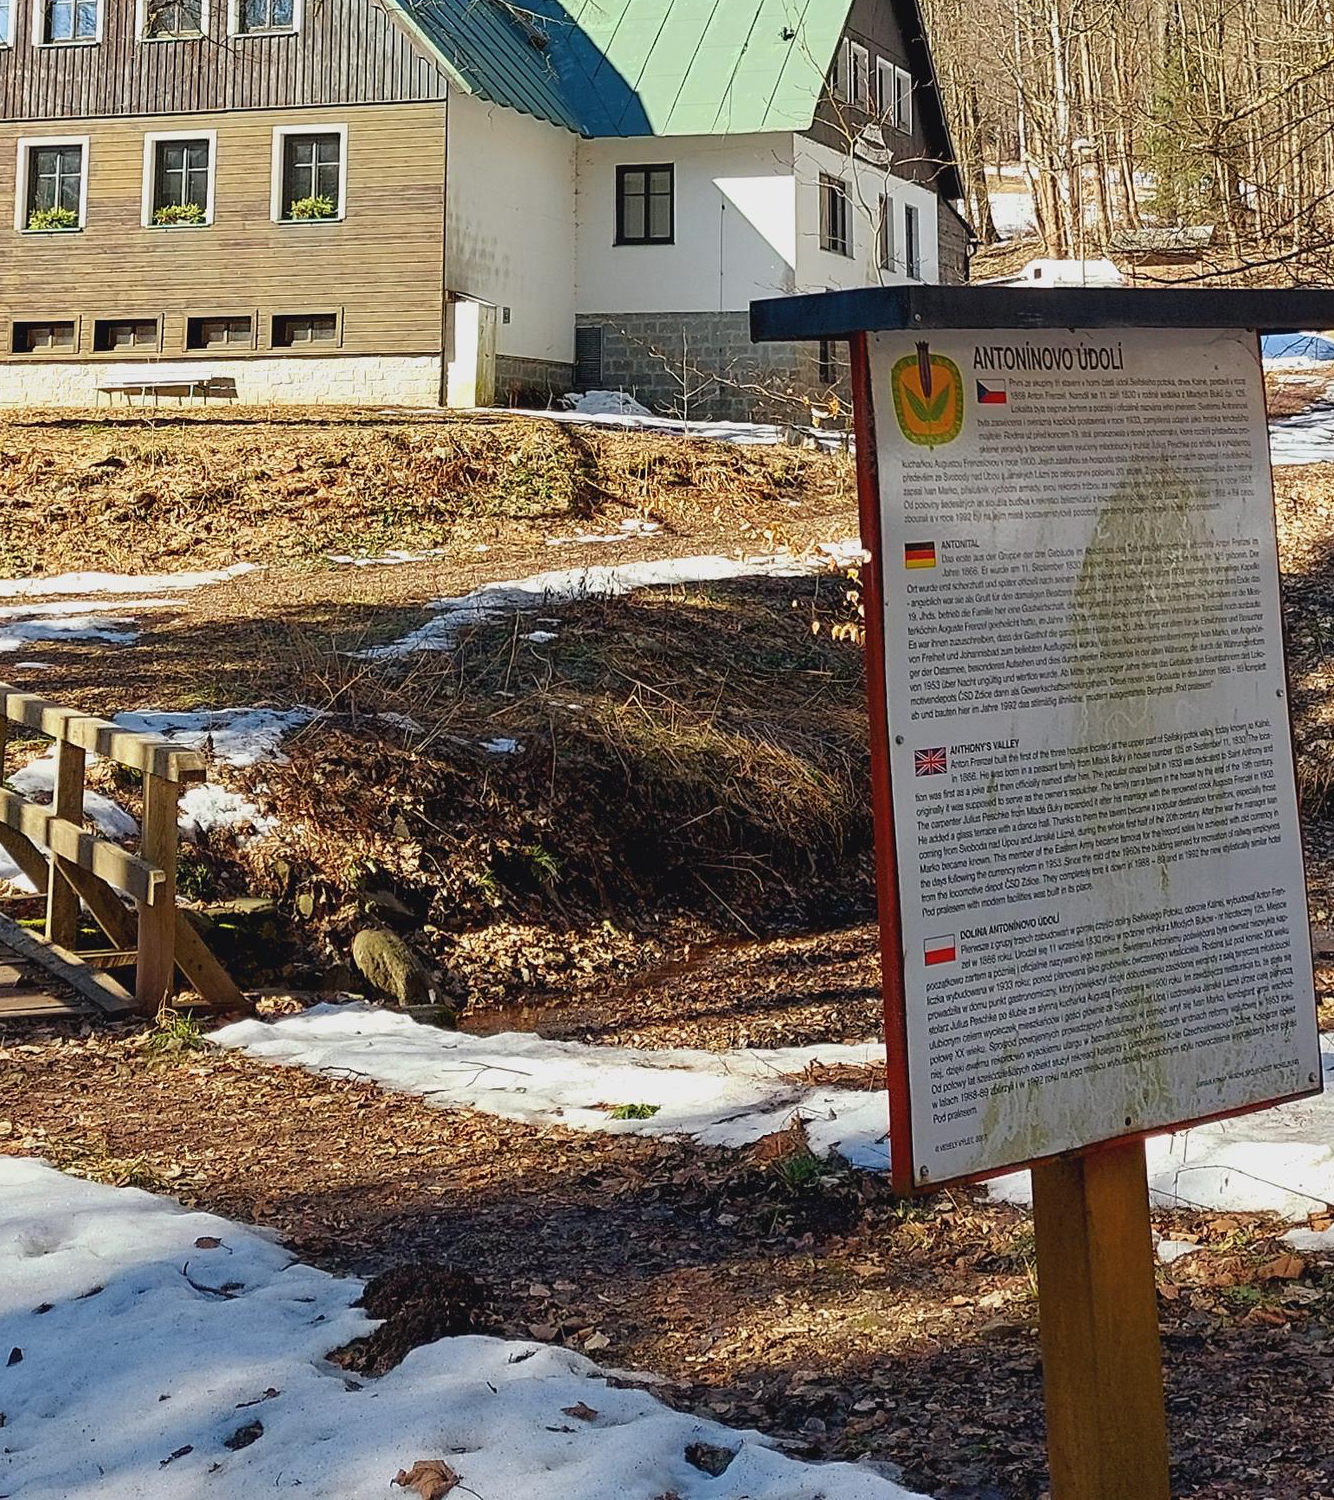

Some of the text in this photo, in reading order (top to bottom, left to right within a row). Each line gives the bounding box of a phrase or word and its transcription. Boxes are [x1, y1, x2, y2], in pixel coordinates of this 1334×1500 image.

[973, 341, 1124, 371] ANTONÍNOVO ÚDOLÍ
[950, 738, 1020, 755] ANTHONY'S VALLEY
[1007, 753, 1019, 762] the
[1031, 750, 1039, 759] of
[1038, 749, 1050, 758] the
[950, 774, 958, 783] in
[979, 771, 990, 780] He
[989, 770, 1004, 778] was
[1020, 766, 1027, 775] in
[927, 791, 942, 799] was
[955, 788, 965, 796] as
[985, 783, 999, 793] and
[944, 803, 950, 812] it
[950, 803, 964, 812] was
[997, 797, 1005, 806] to
[1023, 794, 1033, 802] as
[1032, 791, 1044, 801] the
[916, 821, 930, 831] The
[917, 835, 928, 844] He
[1074, 814, 1082, 823] to
[987, 839, 1001, 850] nad
[1035, 847, 1042, 856] of
[1042, 846, 1054, 855] the
[919, 878, 931, 888] the
[975, 869, 987, 879] the
[1037, 861, 1044, 870] in
[1081, 853, 1092, 863] the
[936, 890, 948, 900] the
[1104, 864, 1110, 873] it
[1126, 860, 1133, 869] in
[921, 906, 936, 917] Pod
[1032, 890, 1046, 899] was
[1060, 886, 1067, 894] in
[1066, 884, 1075, 893] its
